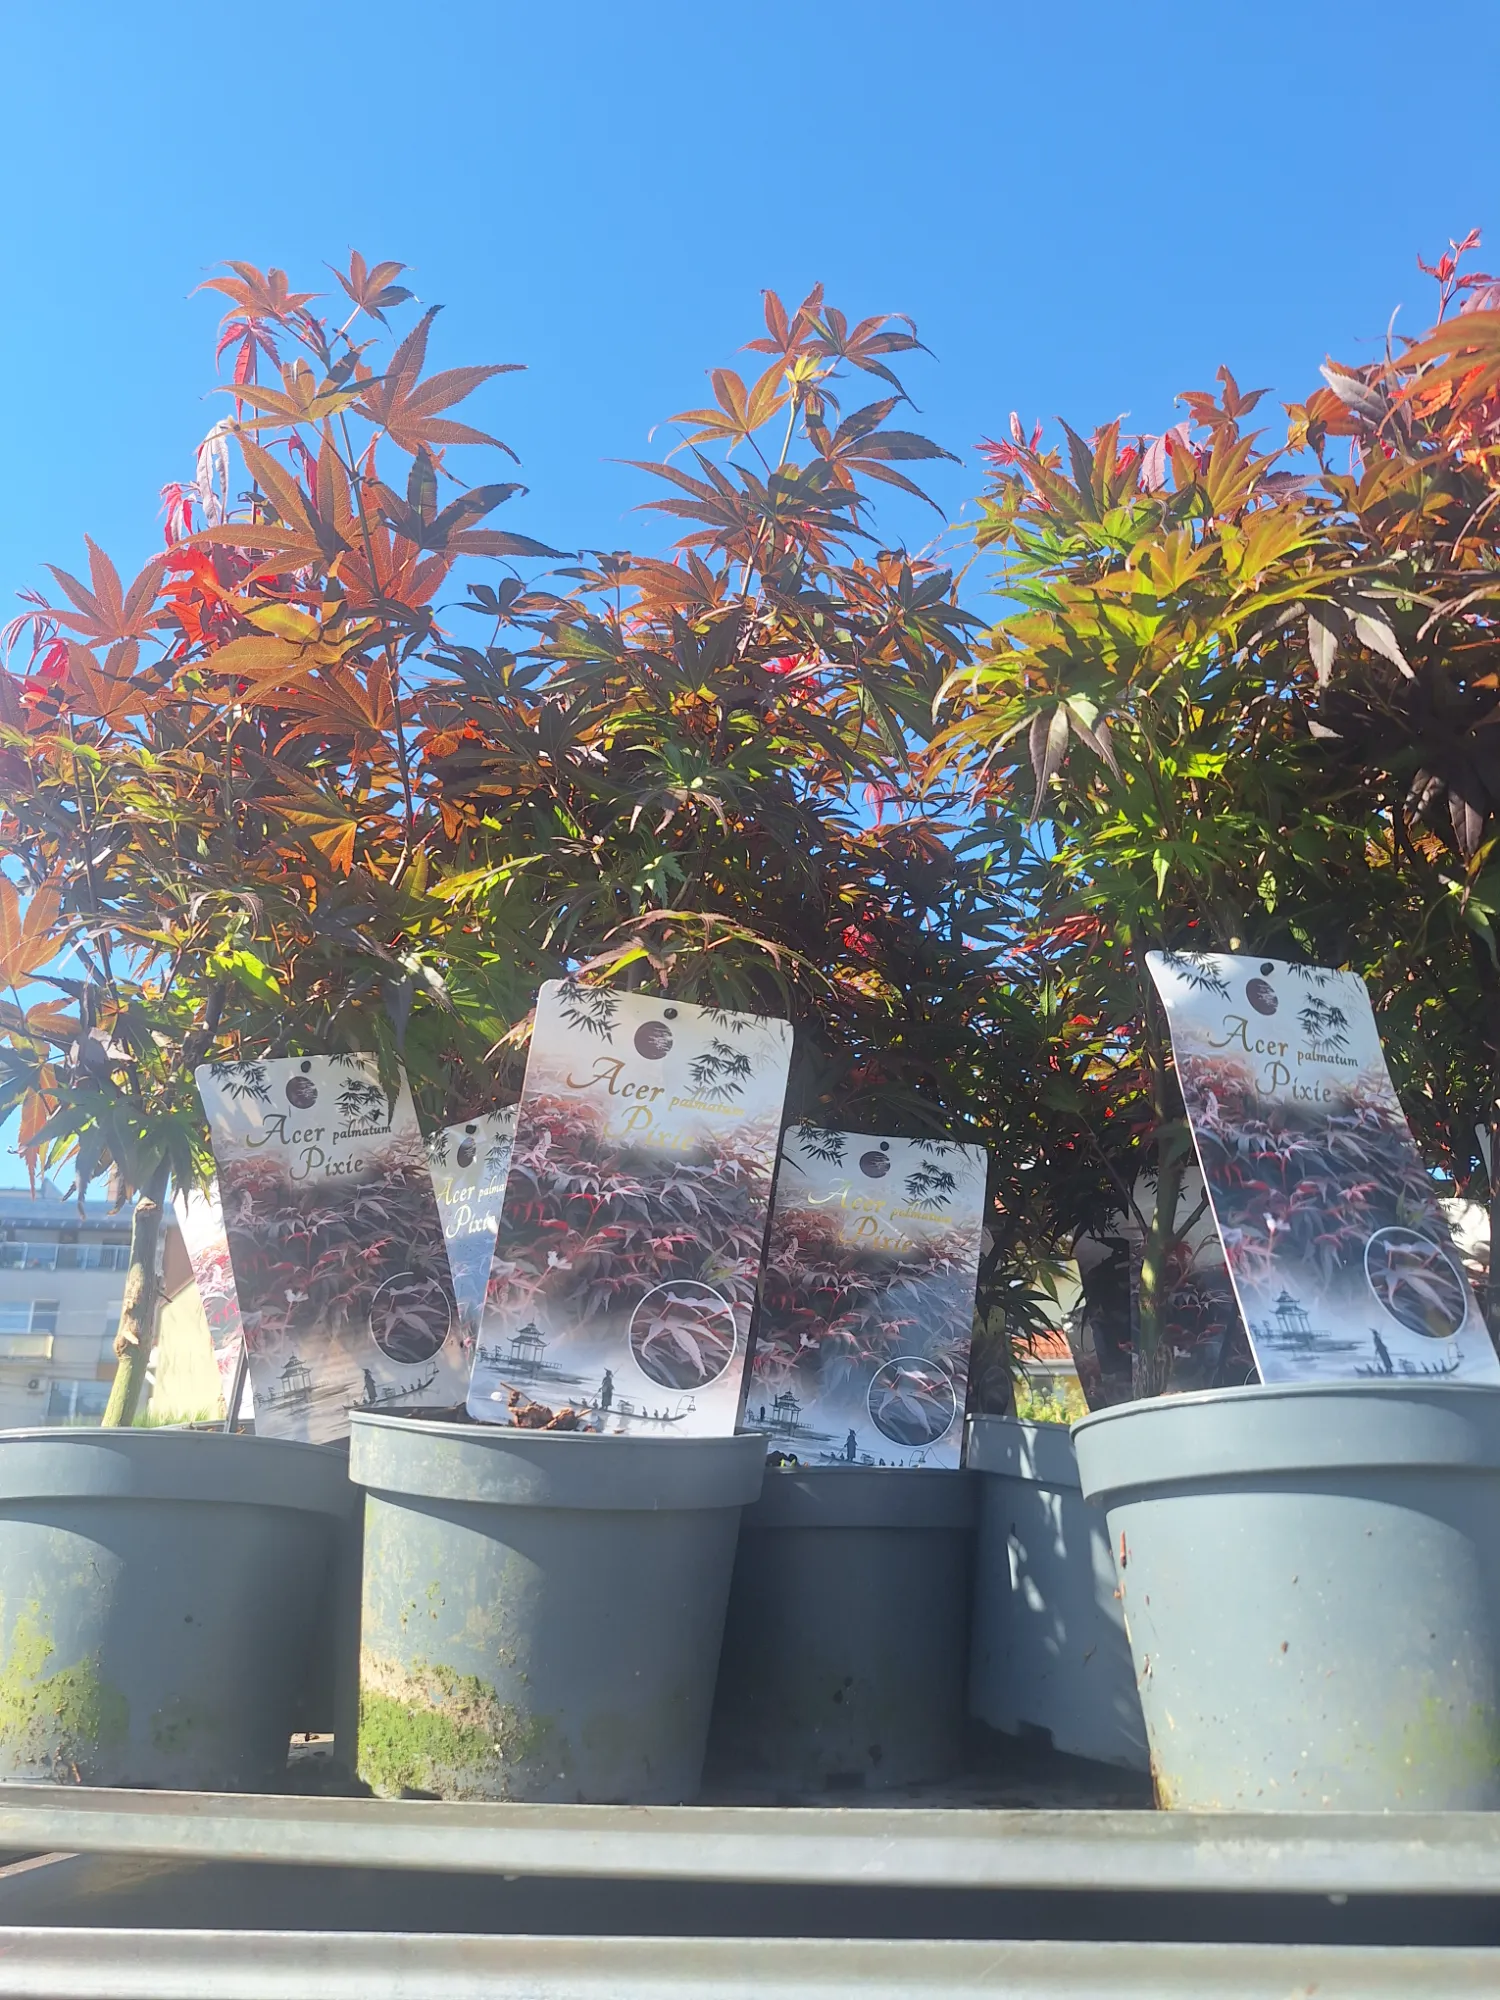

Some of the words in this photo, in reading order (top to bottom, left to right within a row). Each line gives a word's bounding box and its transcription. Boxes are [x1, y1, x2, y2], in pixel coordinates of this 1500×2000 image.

[1207, 1014, 1289, 1057] Acer
[1297, 1043, 1359, 1067] palmatum
[566, 1056, 665, 1102] Acer
[667, 1086, 746, 1116] palmatum
[1255, 1060, 1332, 1103] Pixie
[246, 1113, 326, 1148] Acer
[332, 1119, 392, 1145] palmatum
[603, 1104, 695, 1151] Pixie
[289, 1145, 364, 1180] Pixie
[437, 1177, 476, 1206] Acer
[477, 1174, 508, 1203] palma
[807, 1177, 887, 1213] Acer
[838, 1215, 914, 1253] Pixie
